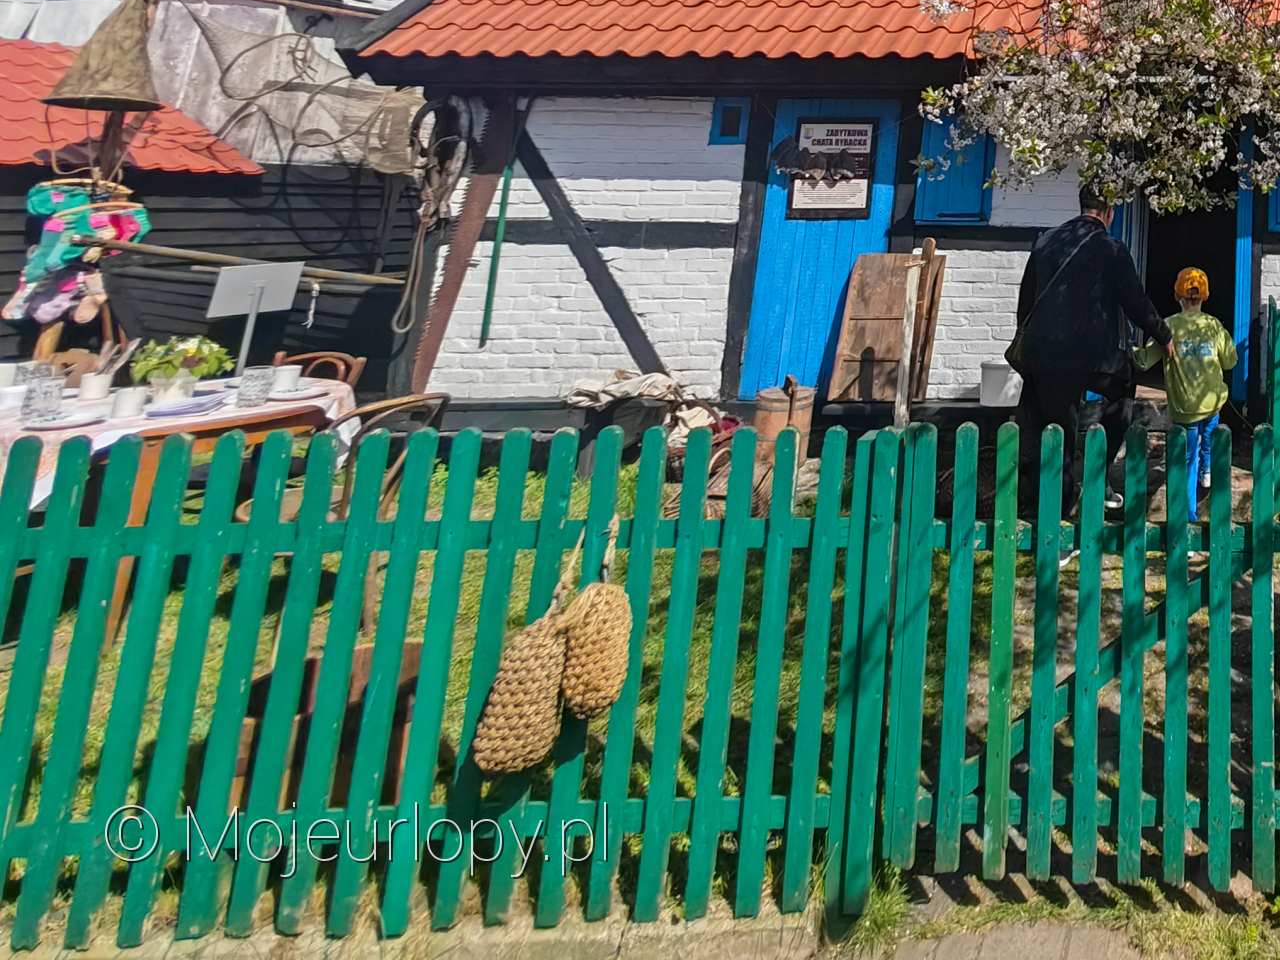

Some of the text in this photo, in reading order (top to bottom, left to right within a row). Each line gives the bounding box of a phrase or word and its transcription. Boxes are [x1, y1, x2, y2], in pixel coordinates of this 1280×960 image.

[825, 128, 868, 137] ZABYTKOWA
[811, 138, 867, 146] CHATA RYBACKA
